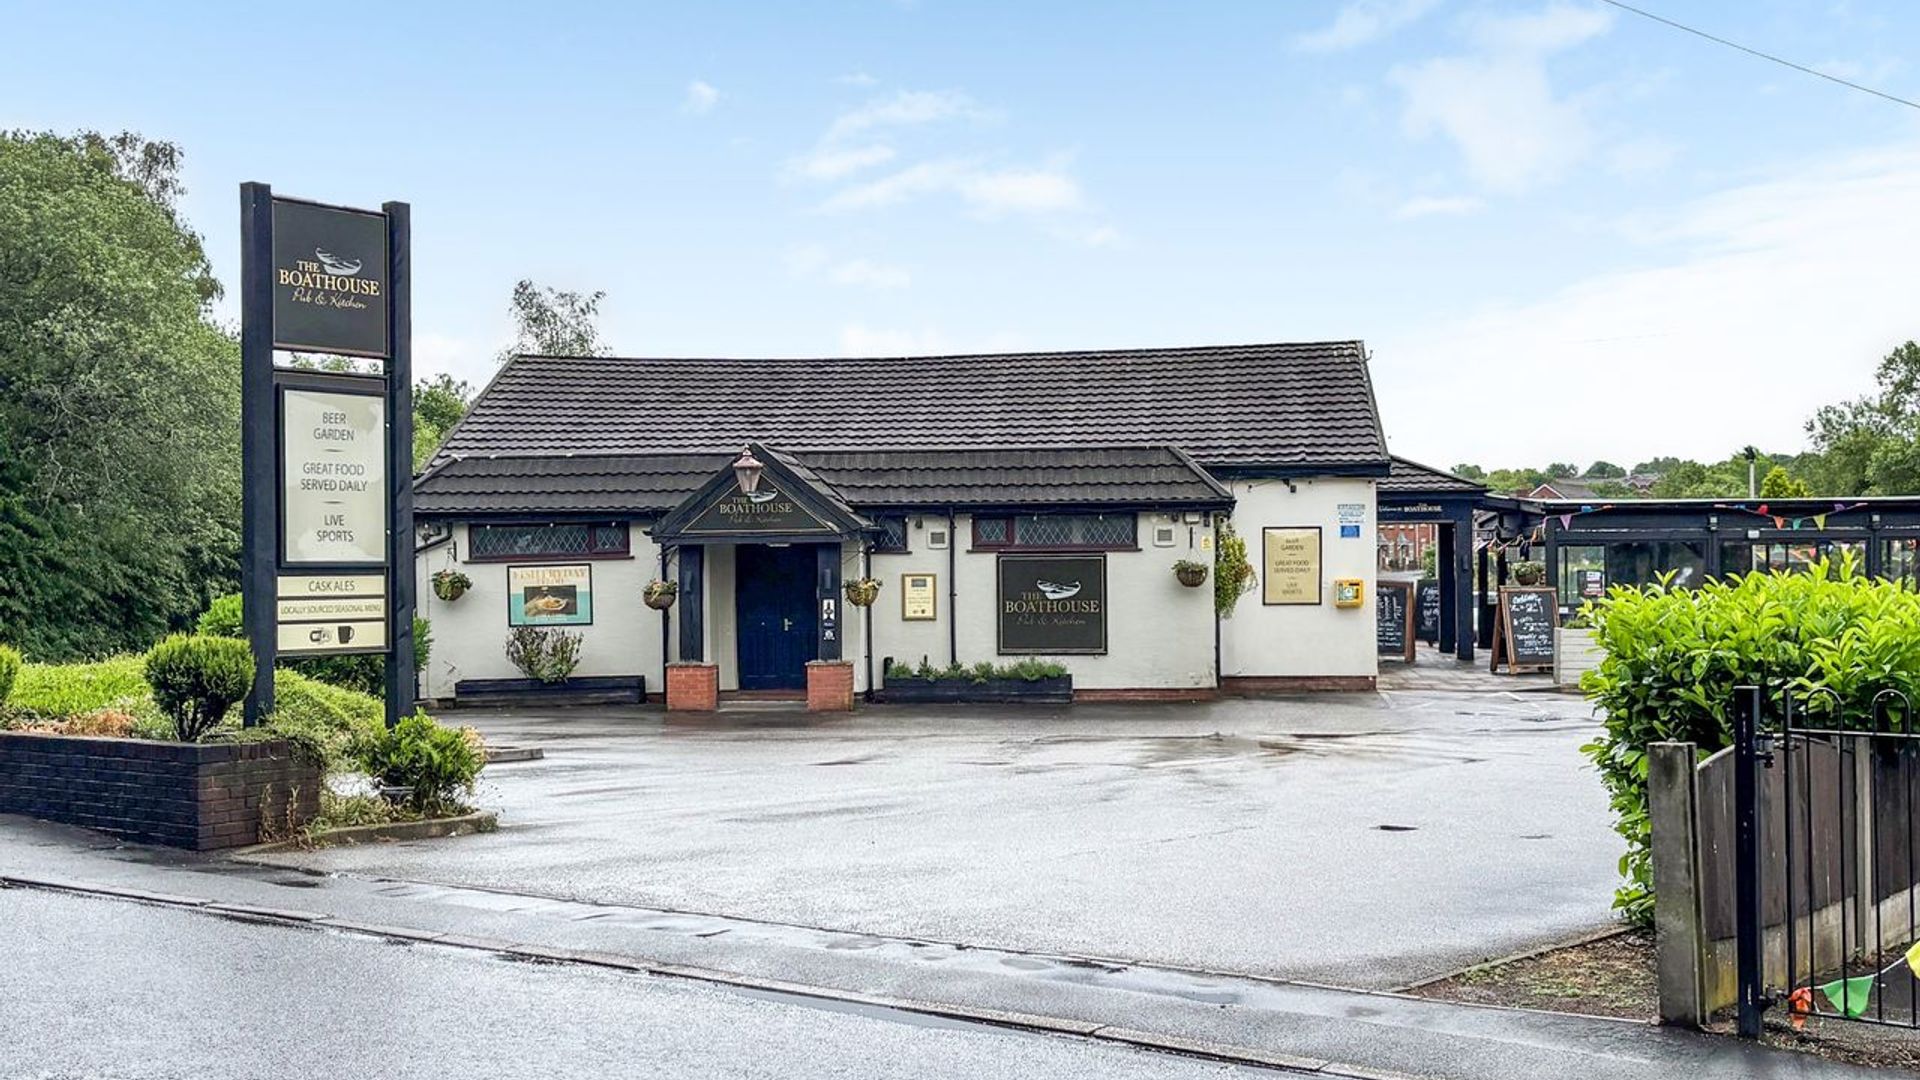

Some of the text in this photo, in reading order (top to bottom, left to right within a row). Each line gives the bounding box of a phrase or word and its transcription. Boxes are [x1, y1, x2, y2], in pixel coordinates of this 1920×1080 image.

[296, 260, 321, 273] THE
[279, 268, 380, 296] BOATHOUSE
[292, 286, 368, 309] Pub & Kitchen
[322, 412, 346, 424] BEER
[313, 427, 355, 441] GARDEN
[303, 462, 365, 476] GREAT FOOD
[300, 479, 368, 492] SERVED DAILY
[719, 503, 793, 514] BOATHOUSE
[324, 515, 345, 526] LIVE
[316, 530, 354, 542] SPORTS
[308, 580, 355, 592] CASK ALES
[280, 605, 307, 614] LOCALLY
[308, 605, 334, 614] SOURCED
[335, 604, 364, 613] SEASONAL
[1005, 600, 1100, 613] BOATHOUSE
